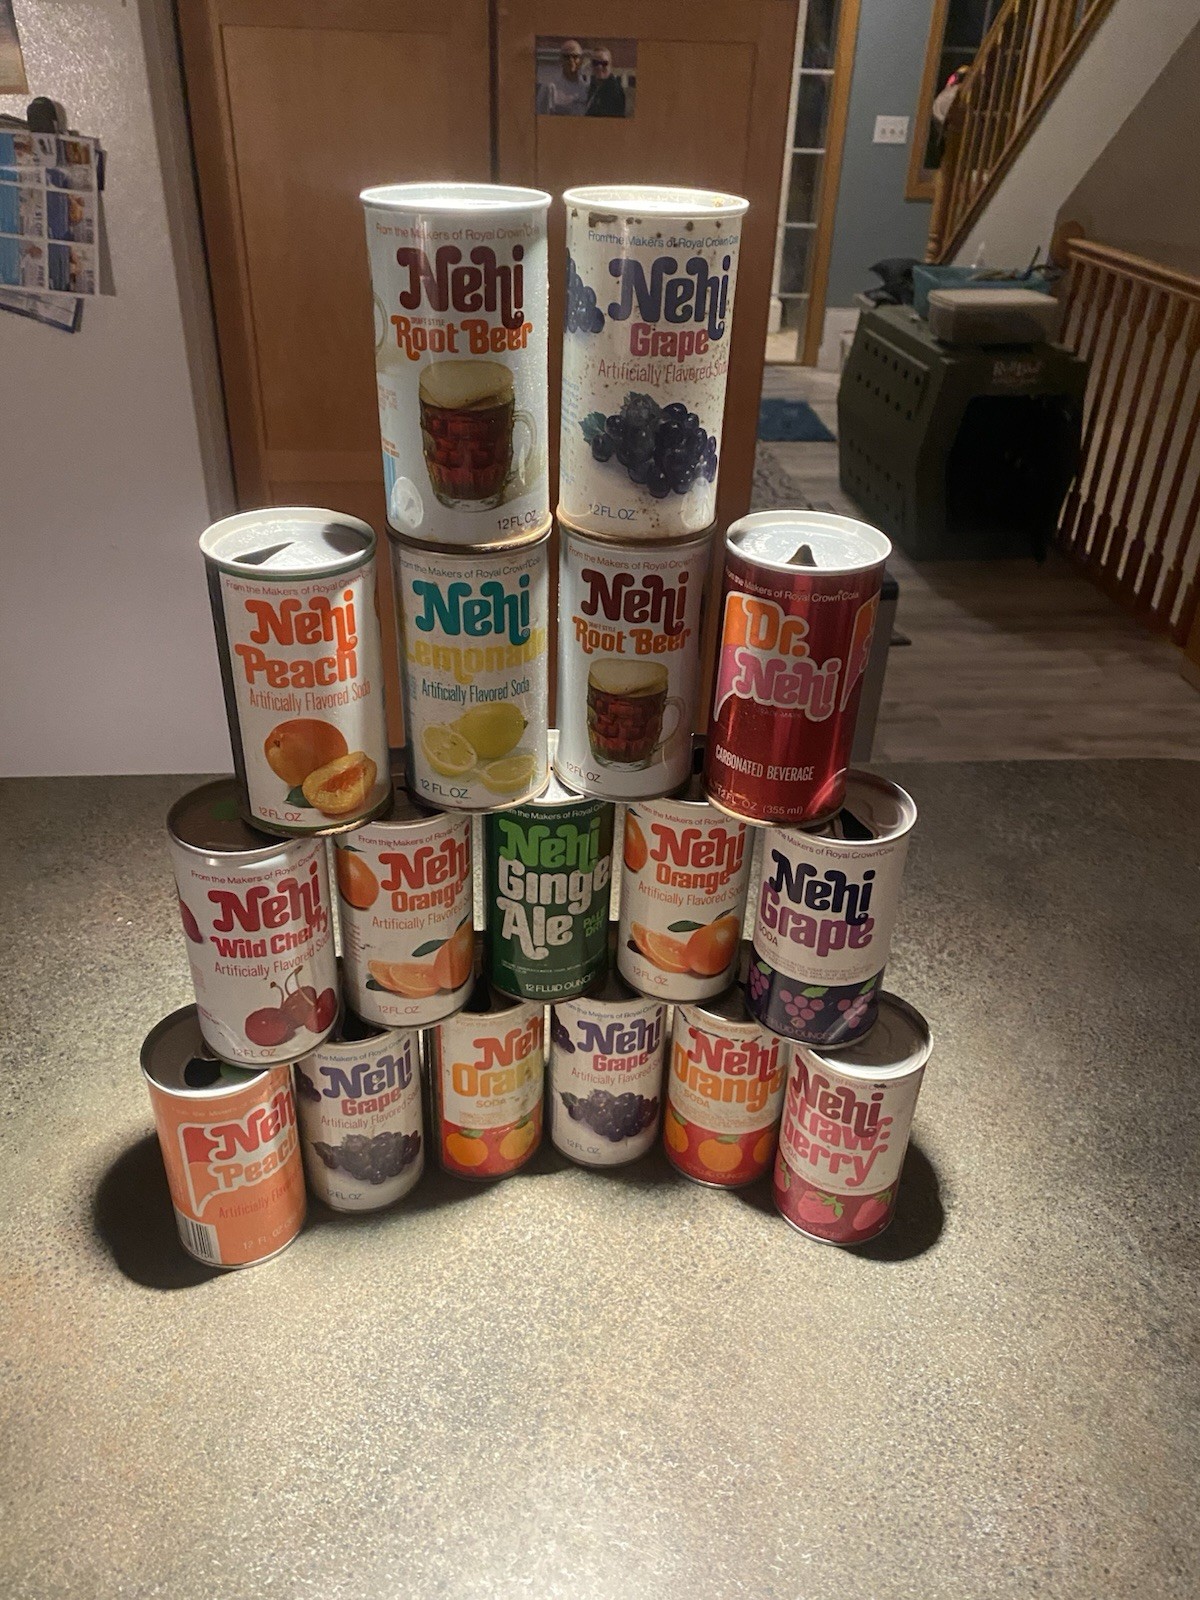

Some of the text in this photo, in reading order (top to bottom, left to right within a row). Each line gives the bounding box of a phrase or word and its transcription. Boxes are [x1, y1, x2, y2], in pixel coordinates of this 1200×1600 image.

[395, 226, 409, 237] the
[411, 228, 450, 240] Makers
[452, 230, 463, 240] of
[466, 229, 494, 242] Royal
[496, 228, 526, 239] Crown
[589, 230, 608, 242] From
[609, 234, 623, 244] the
[627, 237, 664, 248] Makers
[678, 237, 704, 249] Royal
[705, 236, 727, 248] Crown
[397, 244, 524, 329] Nehi
[608, 255, 730, 340] Nehi
[391, 315, 532, 361] Root Beer
[630, 323, 709, 362] Grape
[598, 359, 712, 383] Artificially Flavored
[428, 567, 462, 578] Makers
[464, 570, 473, 578] of
[476, 569, 501, 578] Royal
[503, 564, 528, 574] Crown
[584, 554, 596, 563] the
[597, 556, 630, 569] Makers
[632, 560, 640, 569] of
[643, 562, 667, 571] Royal
[226, 579, 244, 591] From
[245, 585, 260, 594] the
[261, 587, 298, 596] Makers
[313, 582, 338, 594] Royal
[581, 568, 688, 636] Nehi
[745, 580, 772, 597] Makers
[773, 590, 782, 599] of
[784, 591, 810, 601] Royal
[812, 594, 839, 602] Crown
[245, 589, 358, 650] Nehi
[412, 574, 530, 646] Nehi
[742, 596, 809, 657] Dr.
[572, 616, 691, 655] Root Beer
[235, 644, 357, 688] Peach
[250, 679, 371, 715] Artificially Flavored Soda
[422, 678, 466, 705] Artificially
[470, 680, 508, 701] Flavored
[511, 676, 530, 697] Soda
[734, 649, 841, 721] Nehi
[715, 745, 815, 781] CARBONATED BEVERAGE
[517, 811, 529, 819] the
[572, 807, 592, 818] Royal
[654, 809, 664, 818] the
[665, 814, 693, 825] Makers
[358, 835, 377, 844] From
[393, 839, 424, 847] Makers
[426, 835, 434, 843] of
[378, 824, 470, 891] Nehi
[499, 817, 600, 874] Nehi
[650, 823, 746, 874] Nehi
[787, 834, 814, 853] Makers
[826, 848, 850, 859] Royal
[851, 851, 878, 859] Crown
[191, 869, 211, 881] From
[211, 876, 225, 884] the
[227, 875, 263, 884] Makers
[264, 872, 273, 881] of
[638, 881, 684, 908] Artificially
[686, 888, 727, 906] Flavored
[656, 863, 731, 895] Orange
[769, 849, 875, 926] Nehi
[208, 861, 324, 932] Nehi
[391, 879, 463, 912] Orange
[209, 935, 267, 959] Wild
[270, 907, 329, 955] Cherry
[372, 916, 425, 930] Artificially
[496, 896, 573, 960] Ale
[760, 880, 874, 957] Grape
[214, 961, 270, 980] Artificially
[273, 947, 315, 973] Flavored
[536, 984, 563, 992] FLUID
[577, 1007, 662, 1055] Nehi
[319, 1039, 412, 1099] Nehi
[592, 1052, 649, 1072] Grape
[687, 1027, 780, 1083] Nehi
[452, 1051, 544, 1097] Oran
[571, 1068, 615, 1086] Artificially
[341, 1086, 402, 1116] Grape
[476, 1099, 506, 1108] SODA
[683, 1089, 710, 1108] SODA
[792, 1054, 884, 1138] Nehi
[321, 1102, 406, 1129] Artificially Flavored
[213, 1126, 297, 1188] Peach
[784, 1108, 888, 1187] berry
[219, 1196, 269, 1219] Artificially
